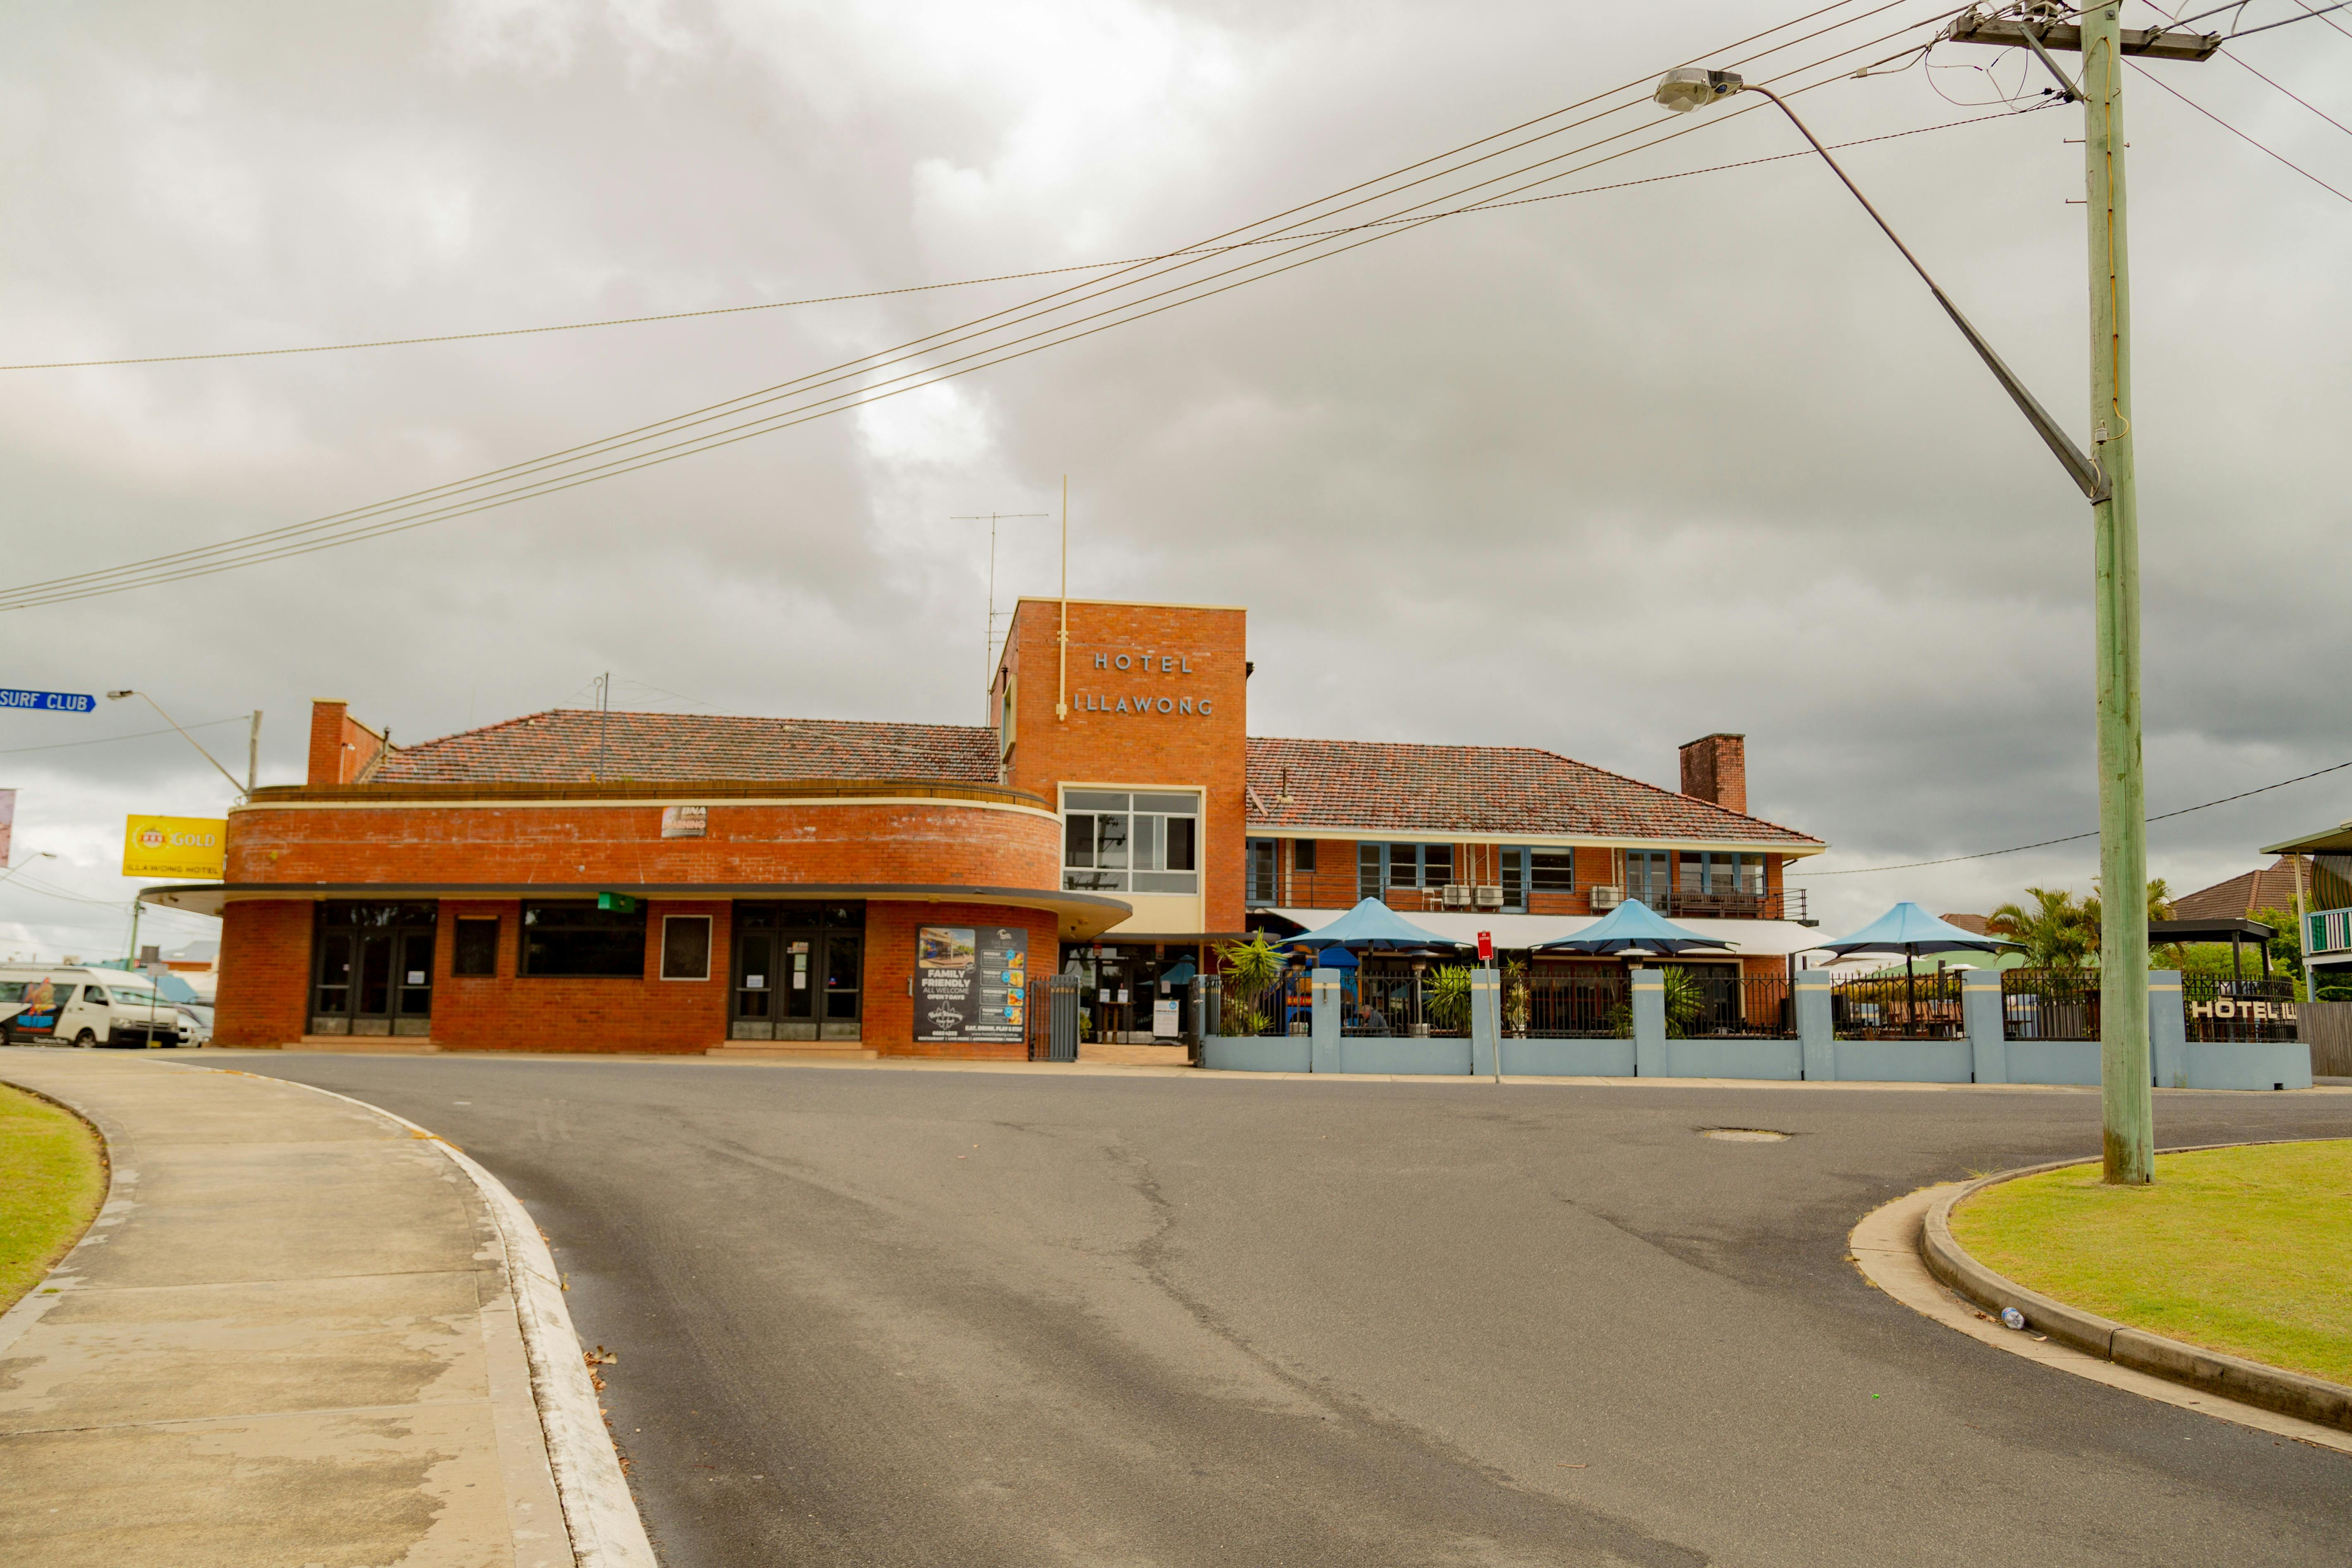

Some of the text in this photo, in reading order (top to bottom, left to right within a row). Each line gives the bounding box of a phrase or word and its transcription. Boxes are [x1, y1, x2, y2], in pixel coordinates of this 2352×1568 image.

[1095, 653, 1192, 673] HOTEL
[0, 691, 88, 711] SURF CLUB
[1074, 694, 1212, 716] ILLAWONG
[665, 820, 706, 829] WARNING
[172, 832, 216, 847] GOLD
[126, 863, 183, 872] ILLAWONG
[928, 969, 965, 978] FAMILY
[922, 978, 971, 987] FRIENDLY
[2192, 1001, 2278, 1019] HOTEL
